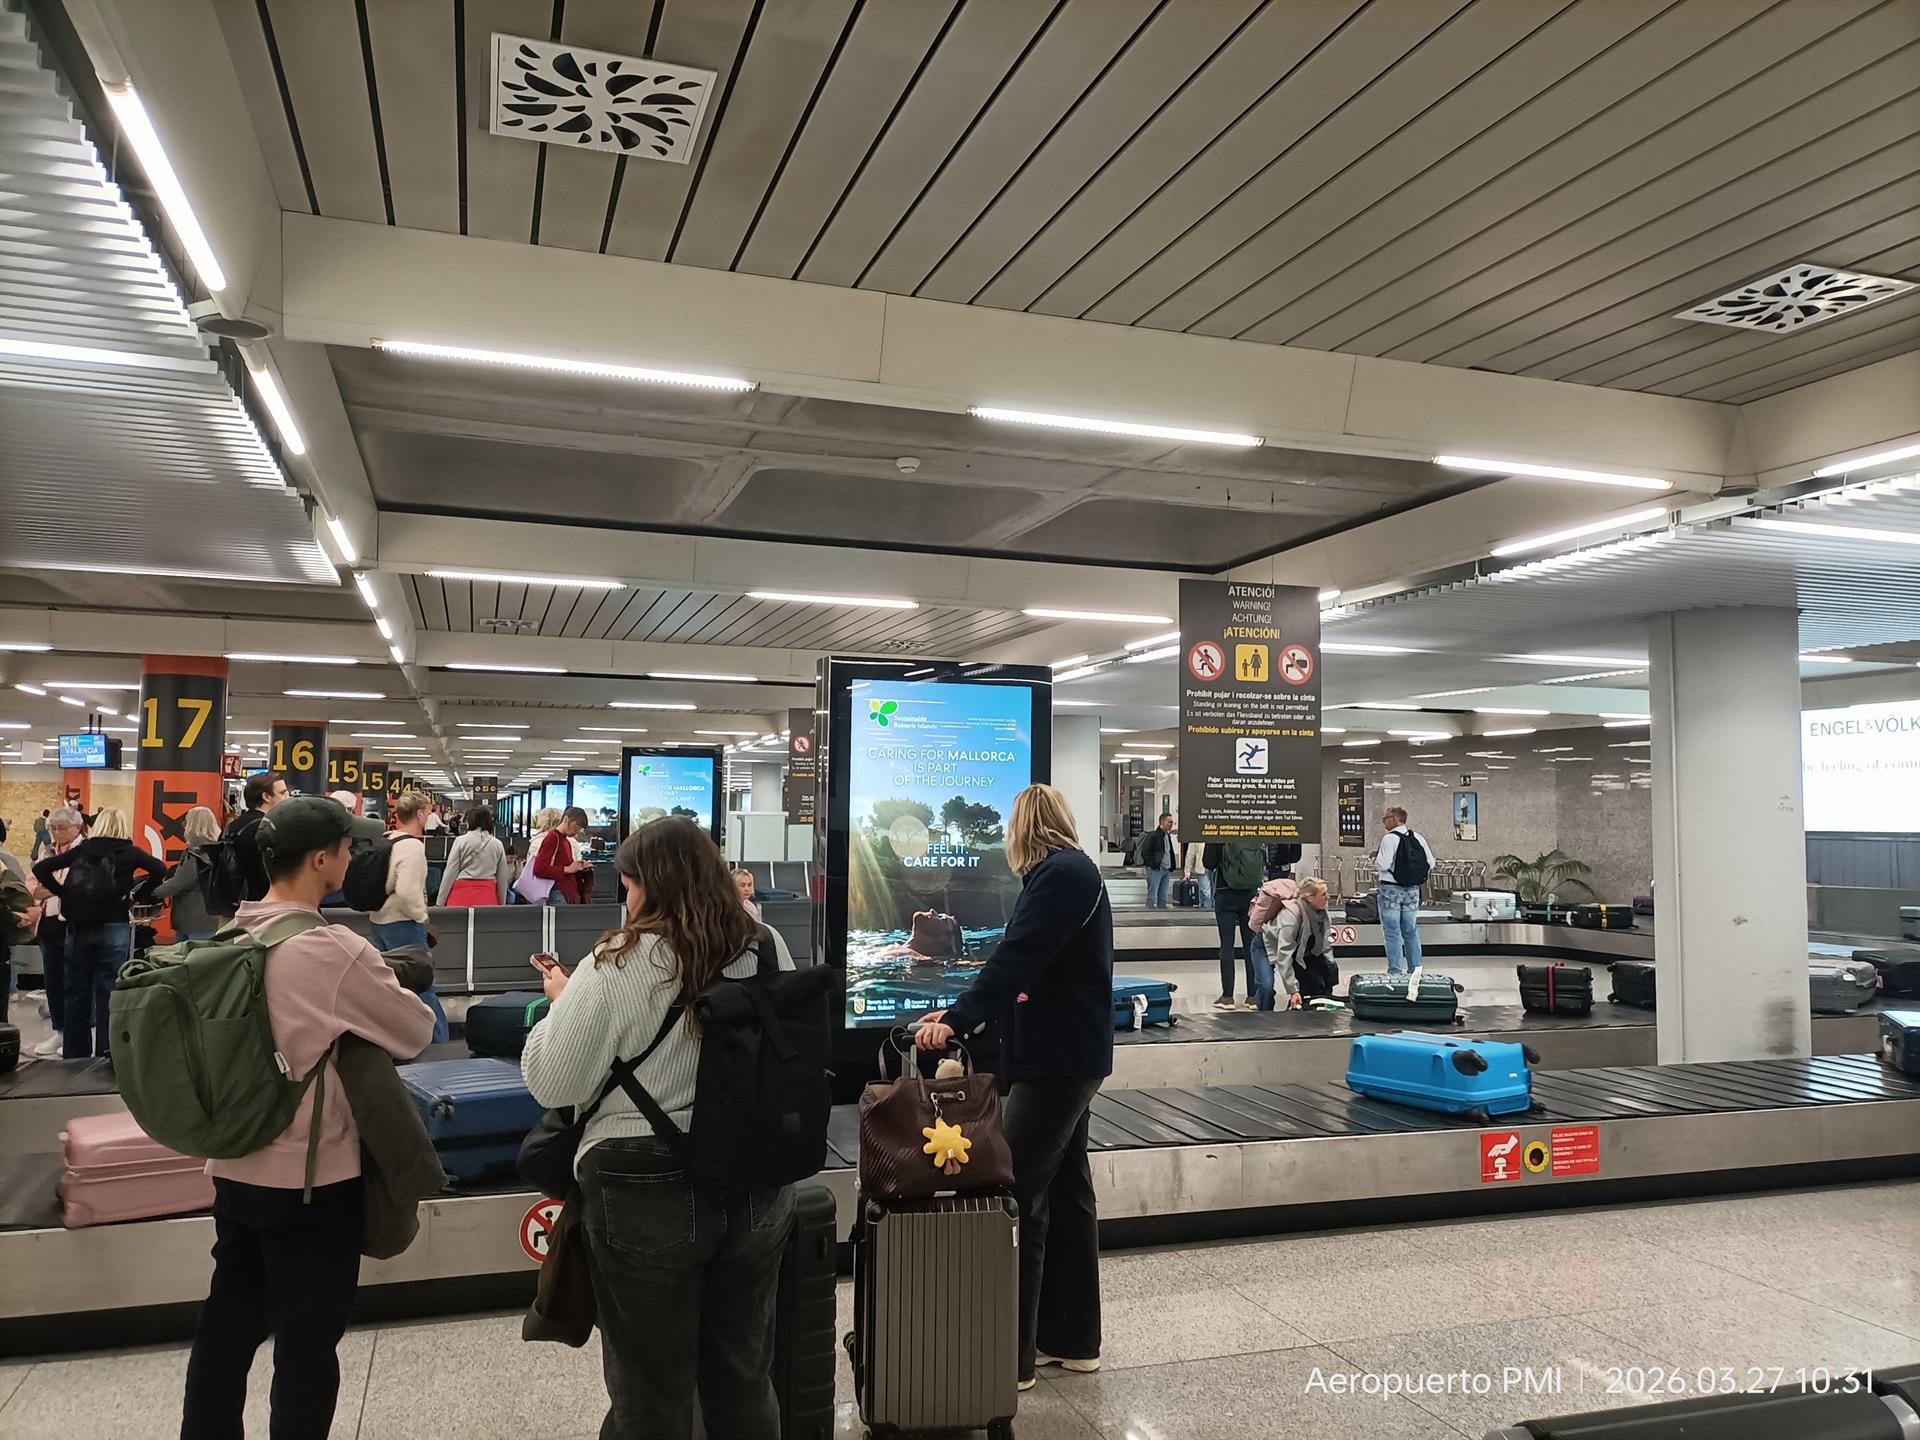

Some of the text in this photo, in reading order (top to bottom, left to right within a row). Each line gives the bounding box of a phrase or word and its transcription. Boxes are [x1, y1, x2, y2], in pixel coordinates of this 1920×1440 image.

[1228, 585, 1275, 598] ATENCIÓ!
[1233, 600, 1271, 612] WARNING!
[1232, 613, 1272, 624] ACHTUNG!
[1224, 625, 1280, 639] ¡ATENCIÓN!
[1186, 689, 1212, 698] Prohibit
[1213, 691, 1230, 699] pujar
[1193, 700, 1215, 708] Standing
[141, 698, 213, 748] 17
[1188, 725, 1219, 733] Prohibido
[1221, 726, 1244, 734] subirse
[65, 747, 99, 755] VALENCIA
[273, 740, 315, 771] 16
[867, 749, 1016, 762] CARING FOR MALLORCA
[328, 760, 359, 783] 15
[914, 762, 958, 773] IS PART
[894, 775, 995, 787] OF THE JOURNEY
[927, 843, 969, 855] FEEL IT.
[903, 856, 980, 868] CARE FOR IT
